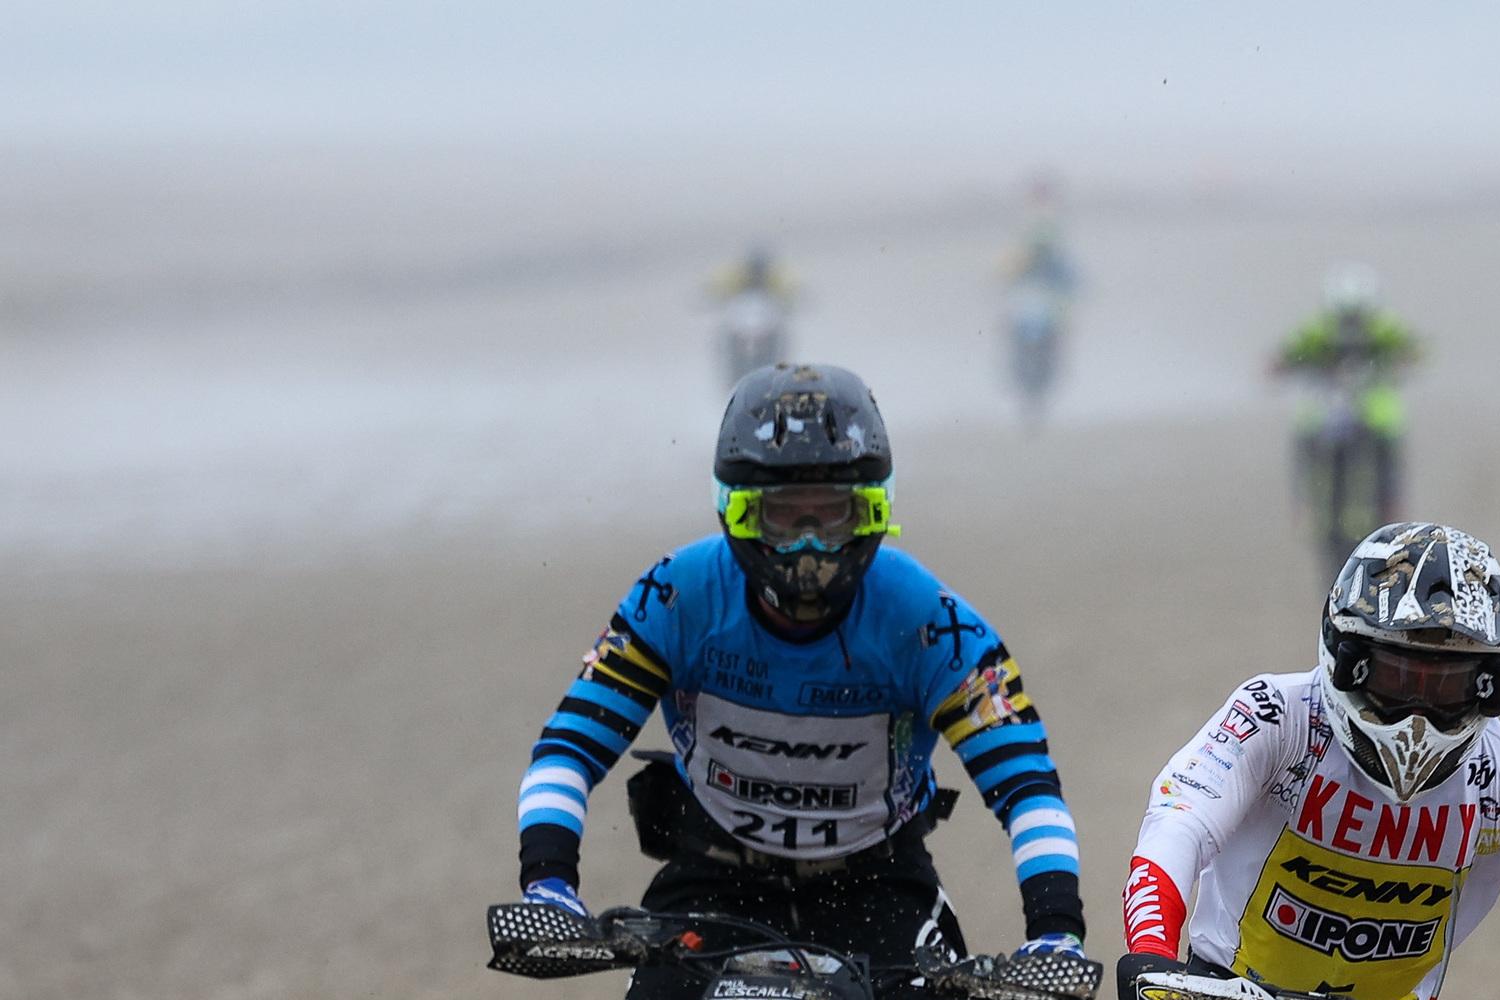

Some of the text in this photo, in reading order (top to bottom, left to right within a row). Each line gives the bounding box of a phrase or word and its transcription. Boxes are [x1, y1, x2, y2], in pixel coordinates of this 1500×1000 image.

[1243, 680, 1284, 726] Dafy
[709, 725, 868, 760] KENNY
[738, 779, 854, 808] IPONE
[733, 810, 839, 850] 211
[1296, 774, 1477, 868] KENNY
[1280, 856, 1453, 906] KENNY
[1299, 909, 1437, 960] IPONE
